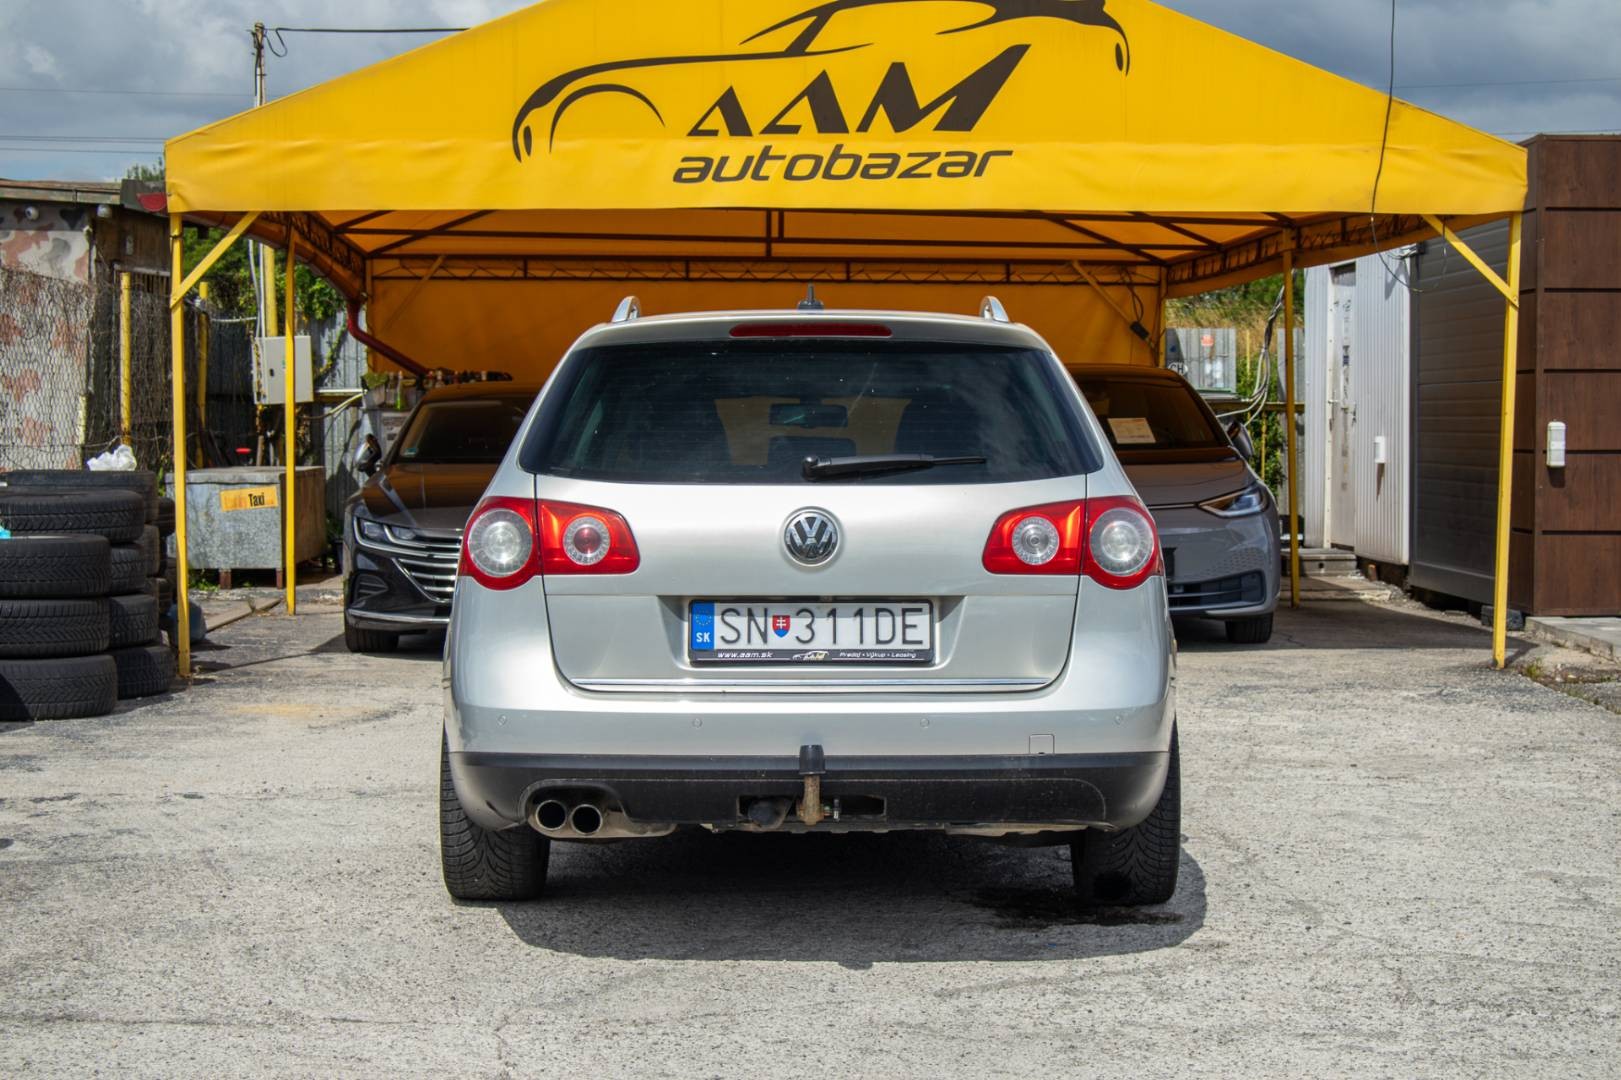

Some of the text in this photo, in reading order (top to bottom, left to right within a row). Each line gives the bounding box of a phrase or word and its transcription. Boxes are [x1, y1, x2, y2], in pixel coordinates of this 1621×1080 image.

[686, 44, 1032, 137] AAM
[672, 144, 1013, 184] autobazar
[248, 492, 265, 507] Taxi
[696, 632, 711, 643] SK
[720, 607, 923, 645] SN 311DE
[891, 651, 917, 659] Leasing
